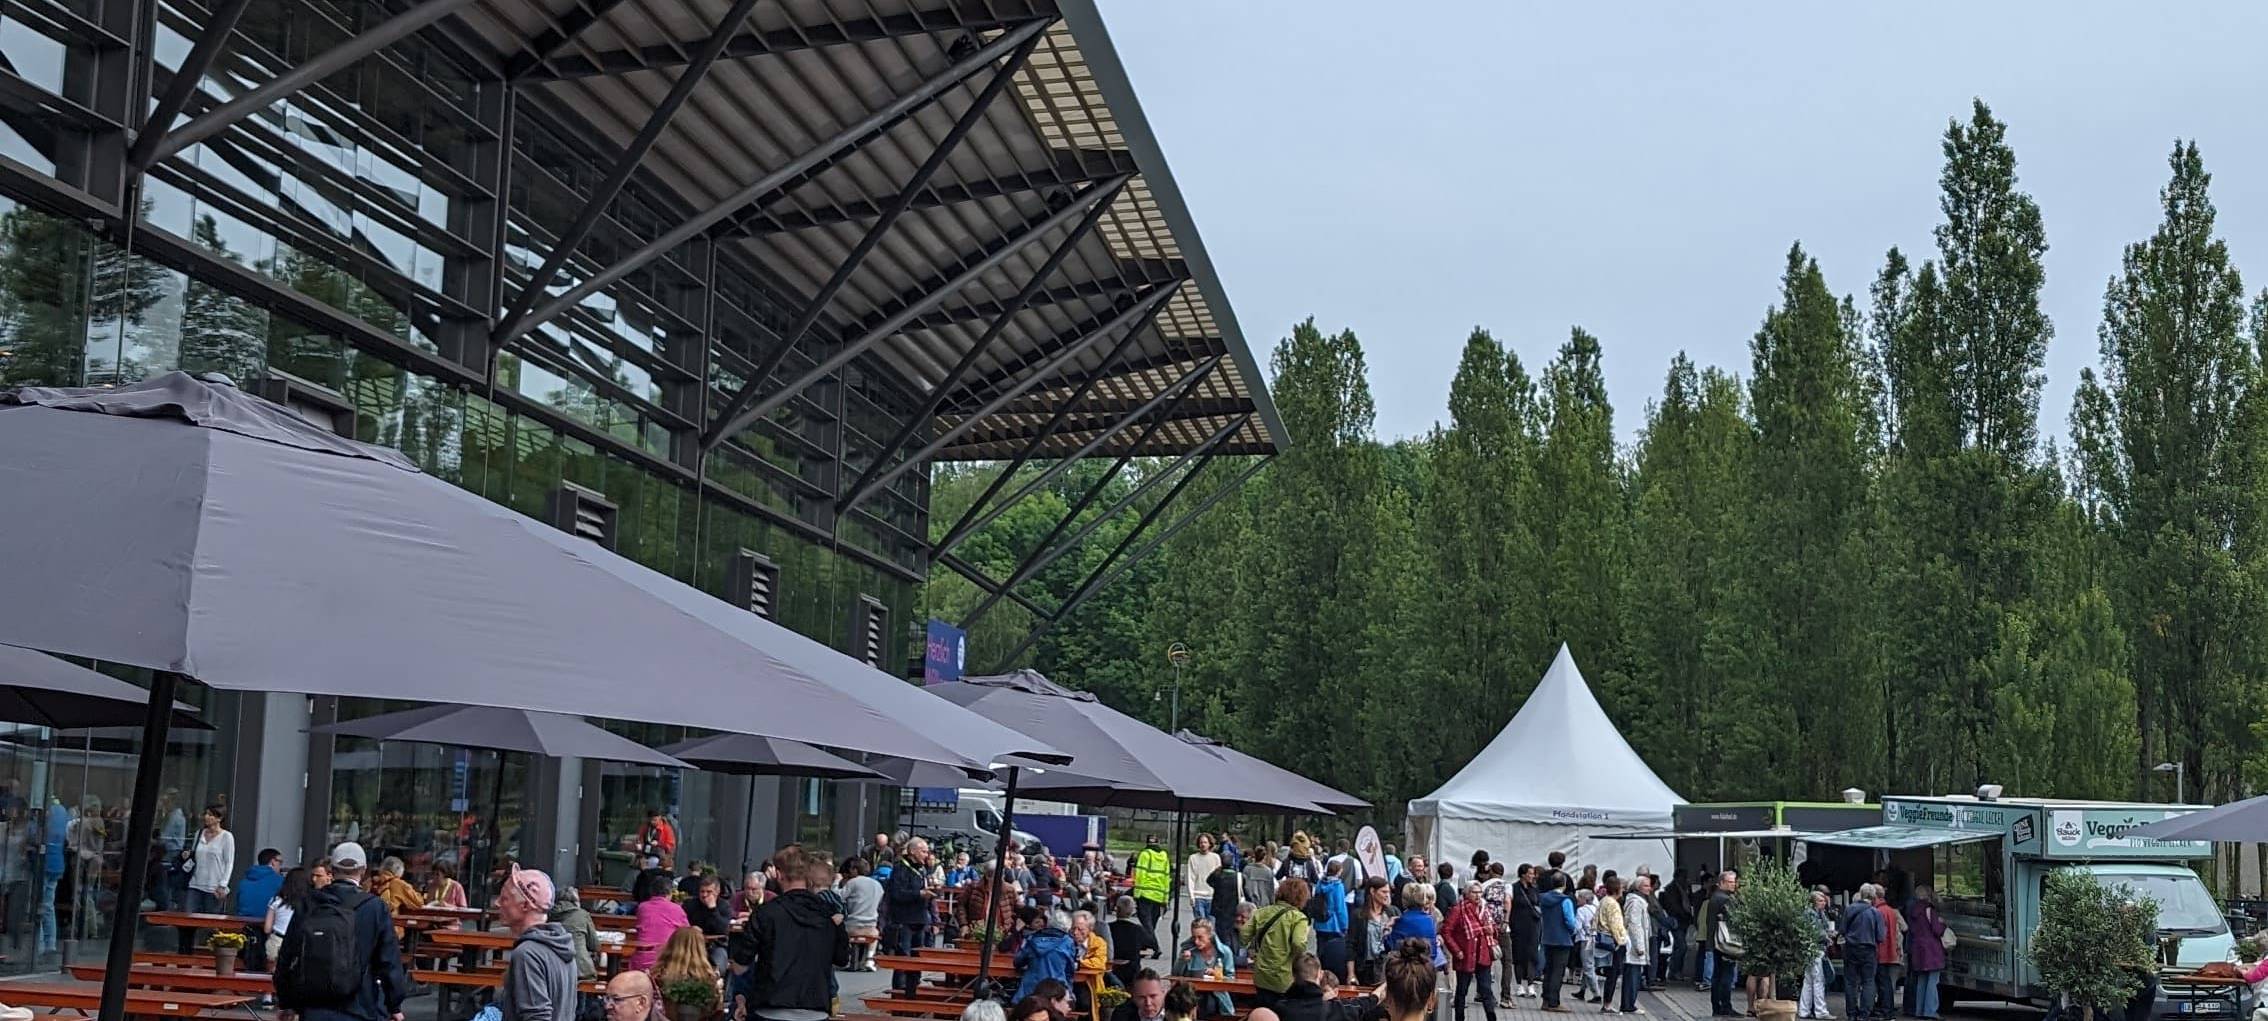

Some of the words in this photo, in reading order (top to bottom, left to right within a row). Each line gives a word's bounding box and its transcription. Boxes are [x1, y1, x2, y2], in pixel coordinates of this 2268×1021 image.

[1552, 810, 1602, 819] Pfandstation
[1900, 804, 1955, 823] VeggieFreunde
[2056, 827, 2081, 836] Bauck
